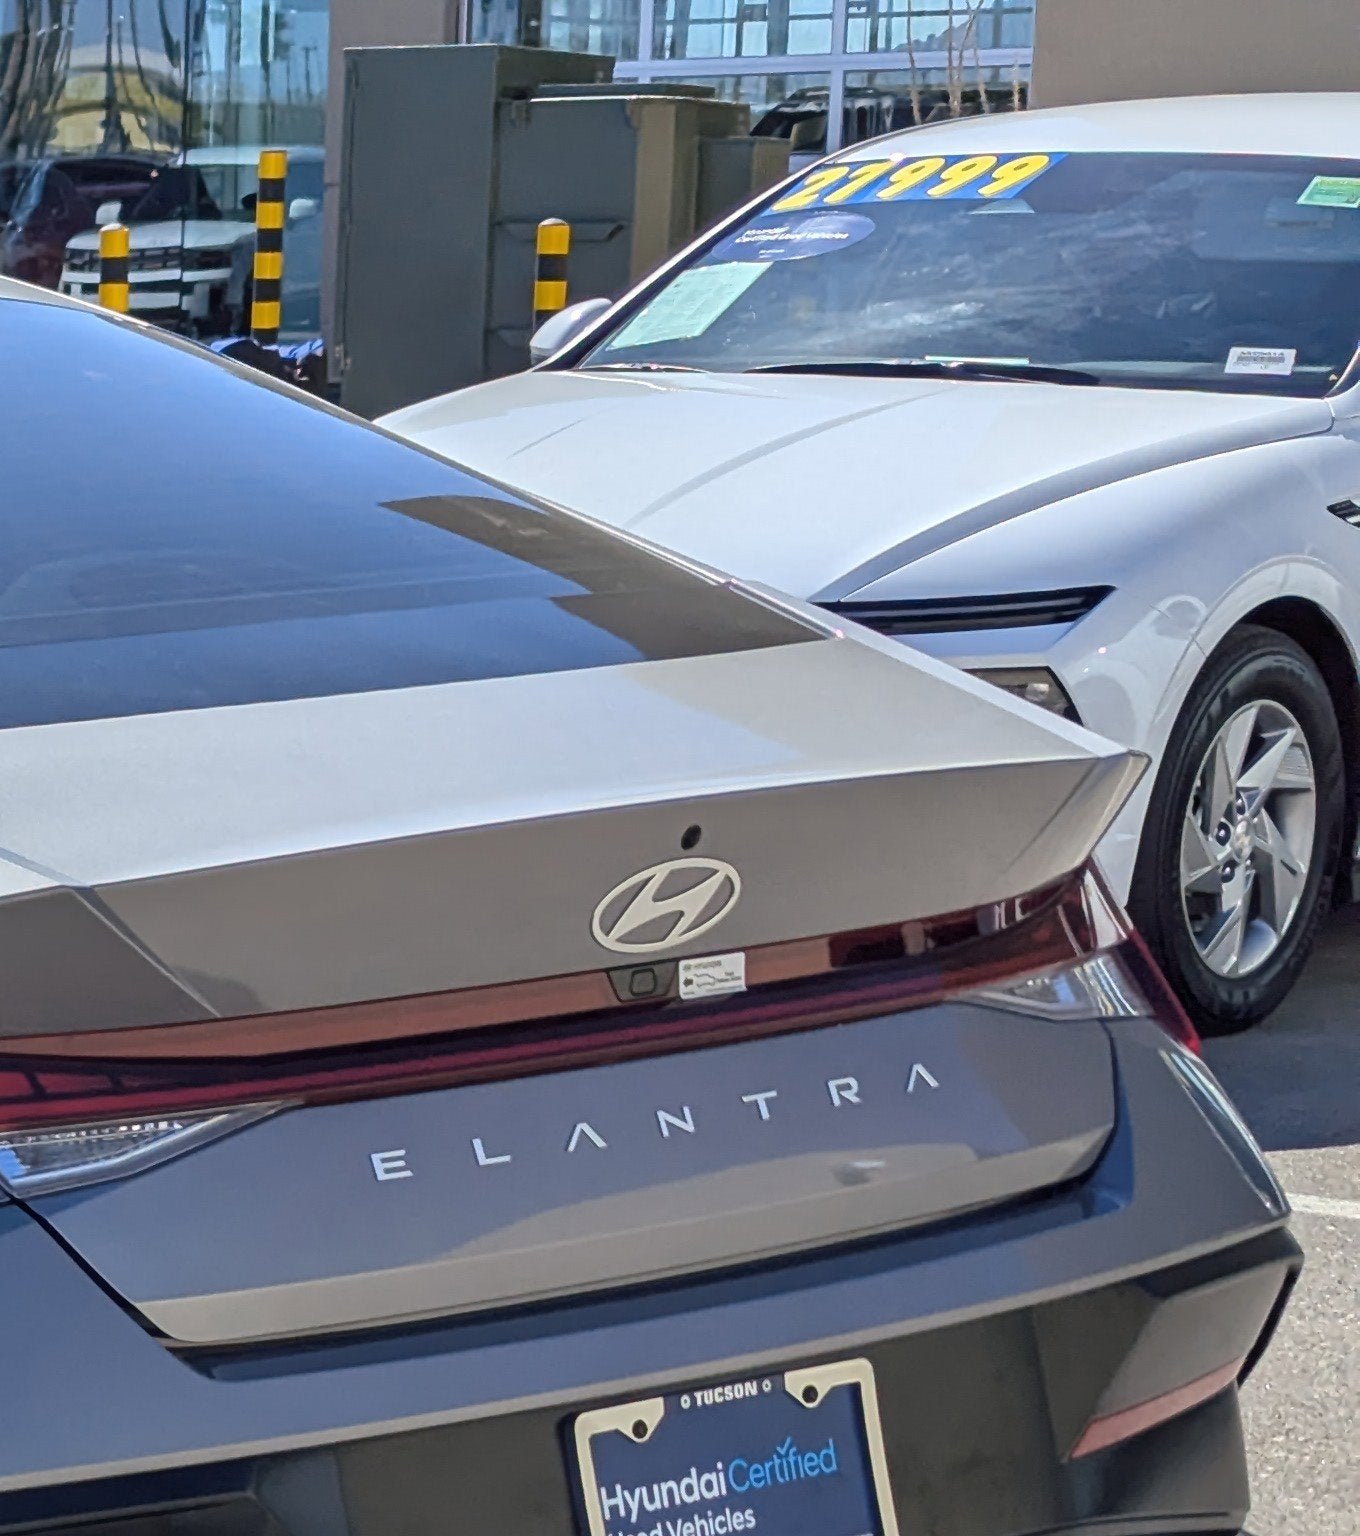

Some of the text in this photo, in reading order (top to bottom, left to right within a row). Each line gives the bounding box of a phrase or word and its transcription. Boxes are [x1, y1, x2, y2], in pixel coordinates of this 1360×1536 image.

[370, 1062, 940, 1182] ELANTRA
[693, 1379, 758, 1408] TUCSON
[600, 1436, 839, 1524] Hyundai Certified
